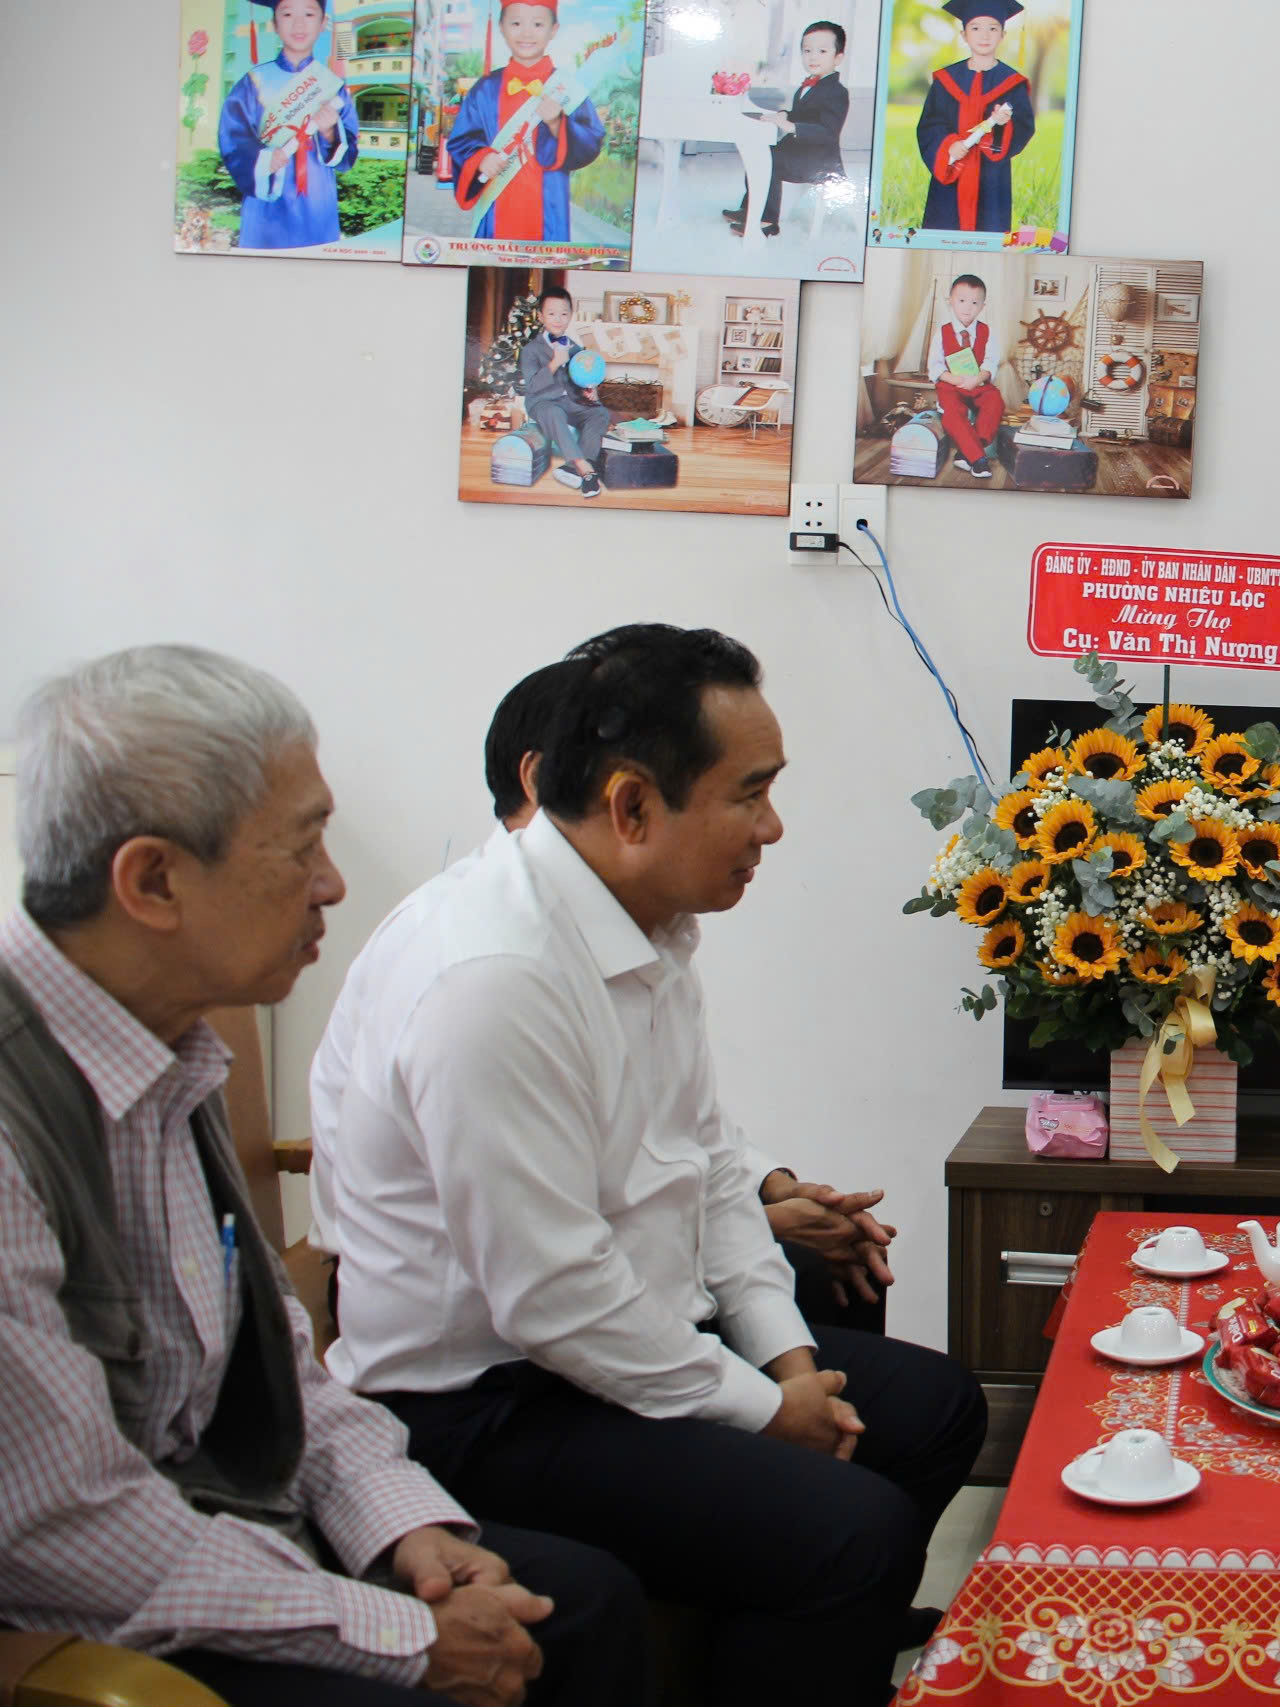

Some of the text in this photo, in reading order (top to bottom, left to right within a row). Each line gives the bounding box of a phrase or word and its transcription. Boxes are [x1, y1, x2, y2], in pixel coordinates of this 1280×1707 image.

[1045, 551, 1074, 574] ĐẢNG
[1077, 552, 1092, 575] ỦY
[1100, 558, 1131, 577] HĐND
[1141, 555, 1156, 578] ỦY
[1157, 561, 1180, 580] BAN
[1182, 560, 1212, 582] NHÂN
[1214, 561, 1237, 584] DÂN
[1081, 581, 1266, 611] PHƯỜNG NHIÊU LỘC
[1111, 604, 1233, 634] Mừng Thọ
[1063, 627, 1279, 665] Cụ: Văn Thị Nượng
